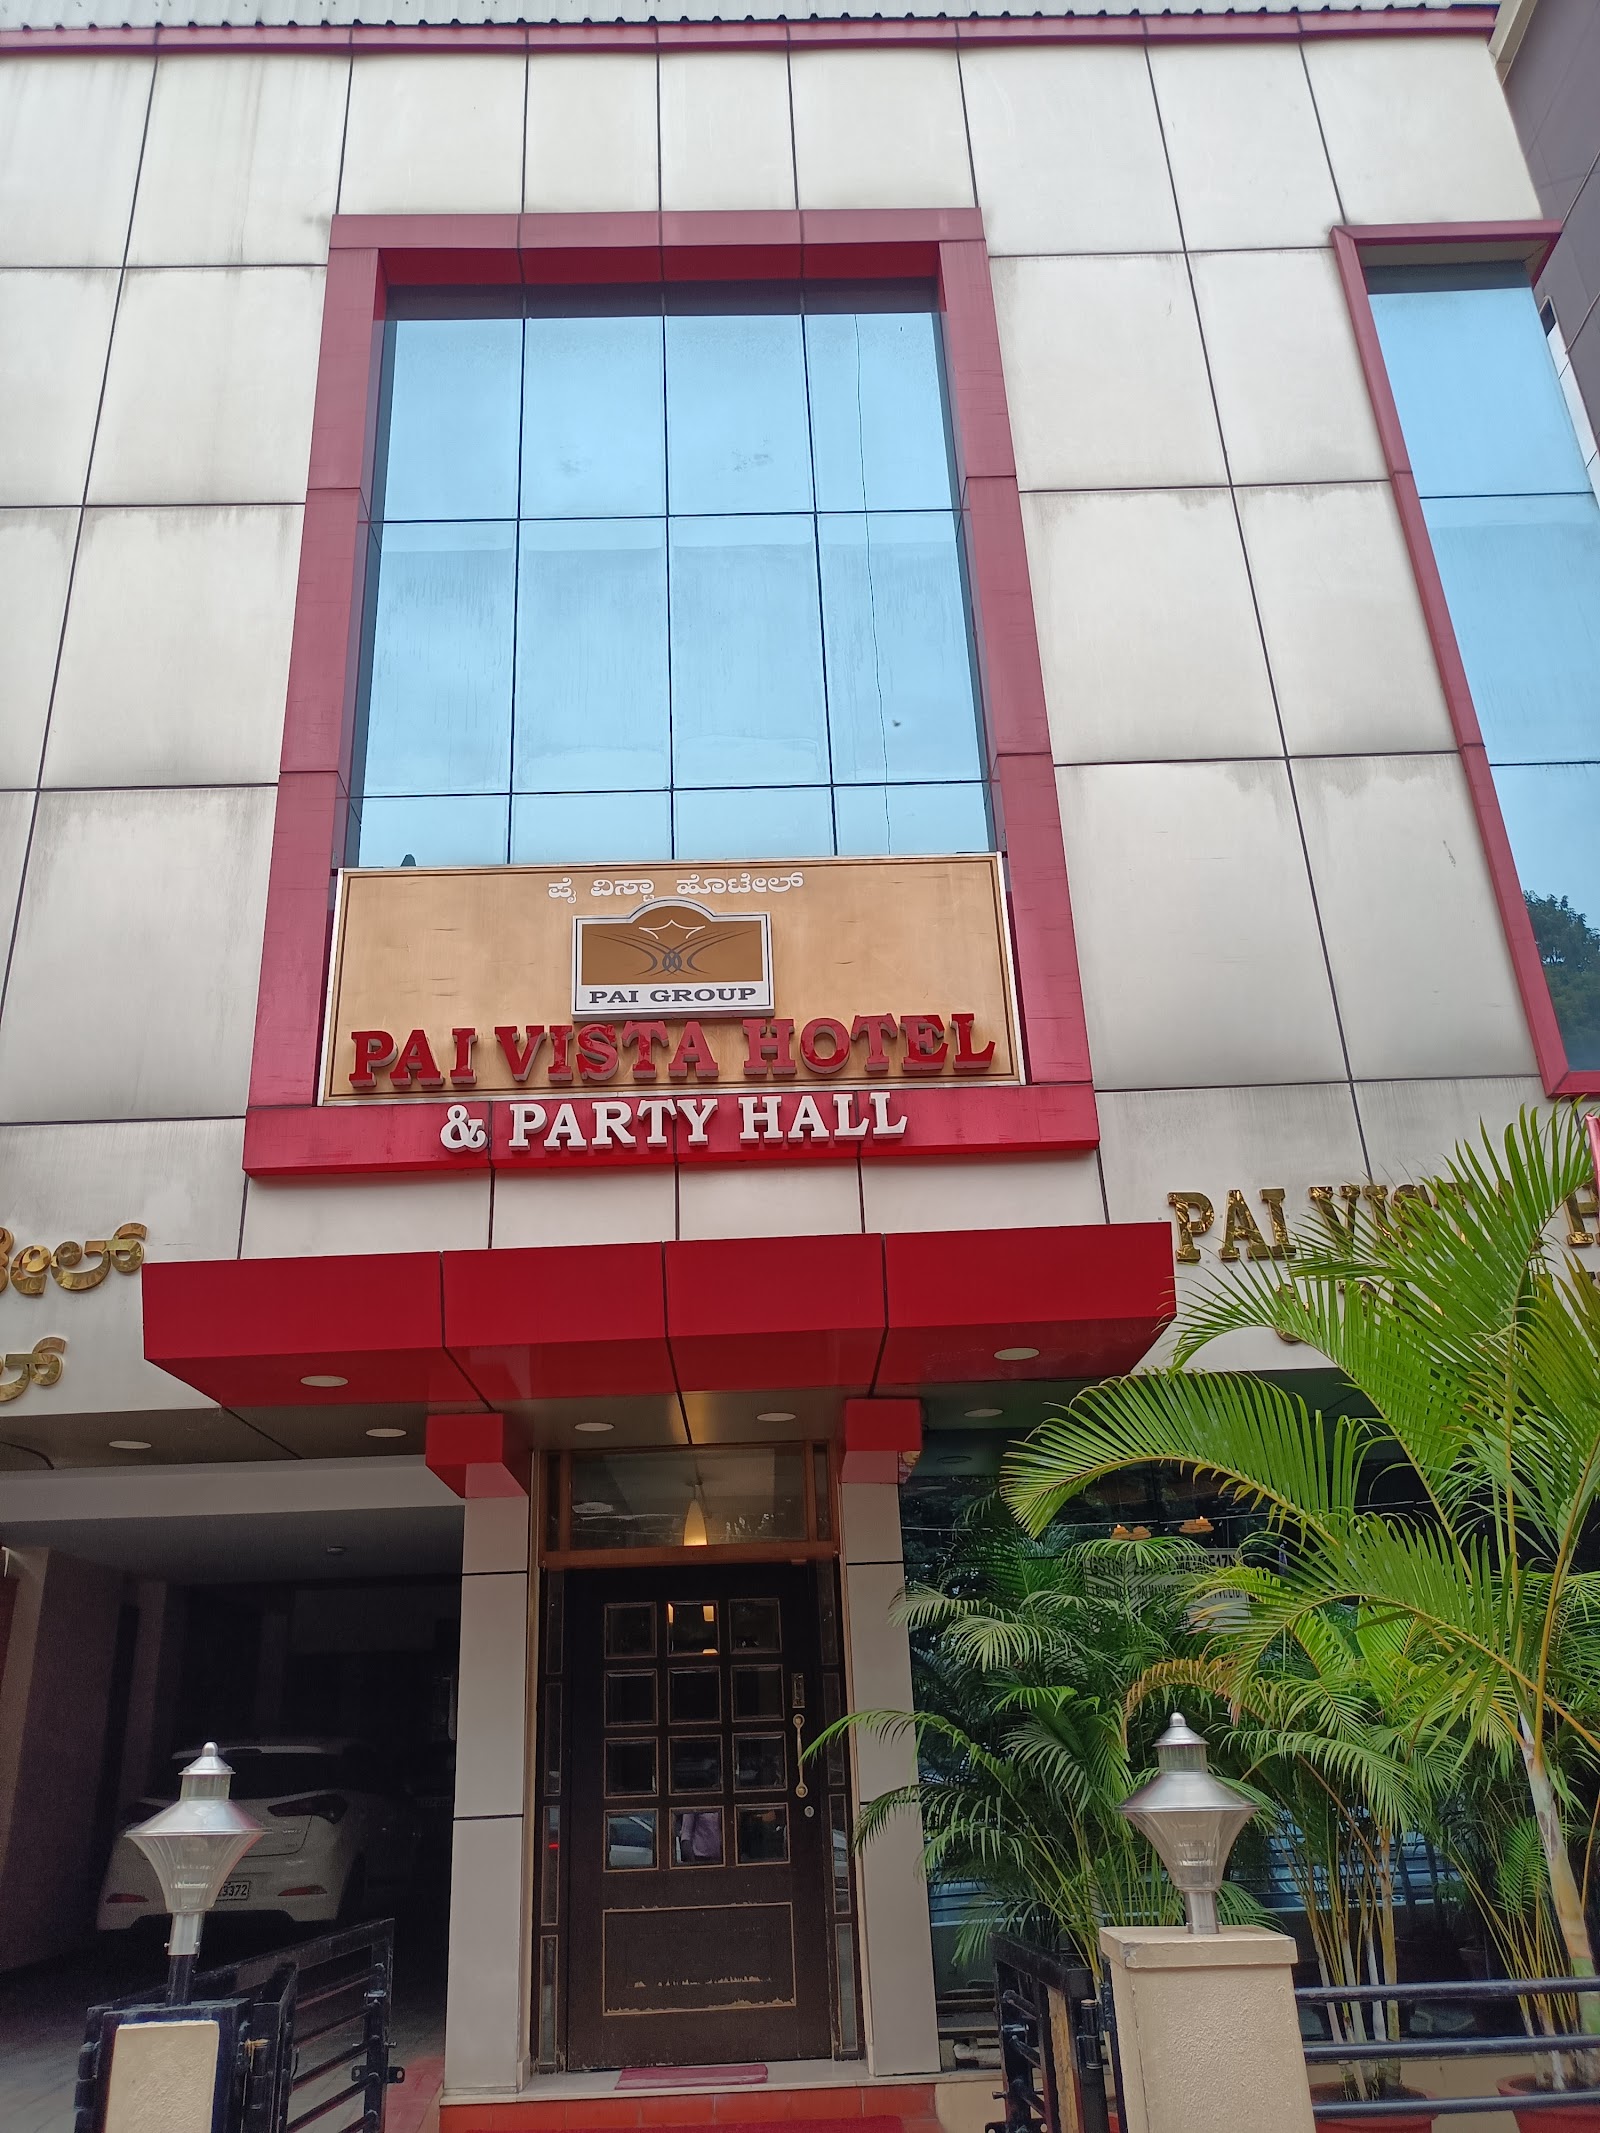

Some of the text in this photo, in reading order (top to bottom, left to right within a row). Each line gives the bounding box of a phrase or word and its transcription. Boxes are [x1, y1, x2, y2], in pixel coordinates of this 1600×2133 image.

[589, 987, 757, 1004] PAI GROUP
[349, 1013, 996, 1088] PAI VISTA HOTEL
[440, 1092, 908, 1153] & PARTY HALL
[1167, 1187, 1297, 1262] PAI
